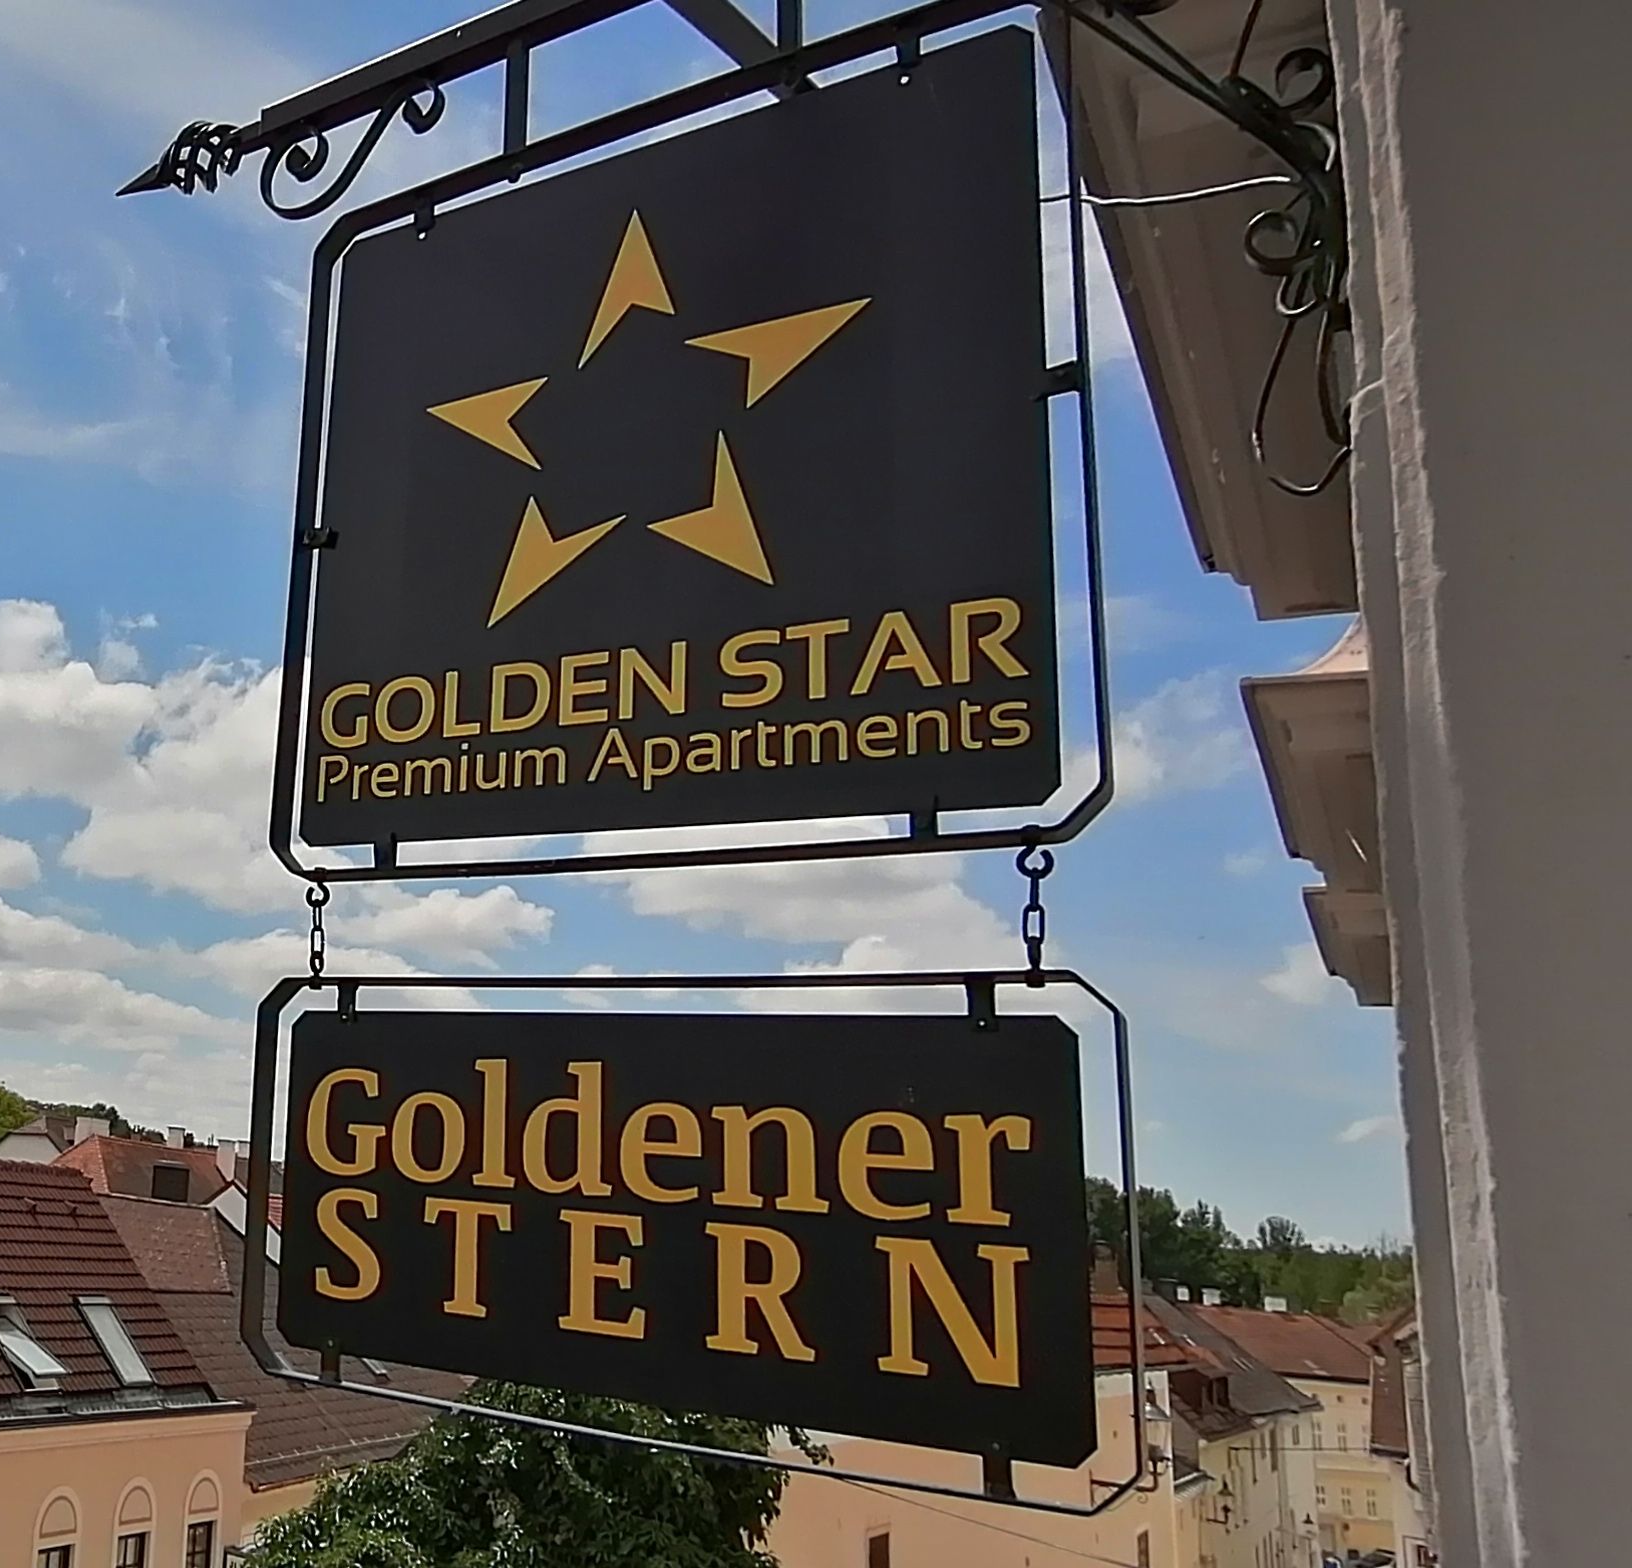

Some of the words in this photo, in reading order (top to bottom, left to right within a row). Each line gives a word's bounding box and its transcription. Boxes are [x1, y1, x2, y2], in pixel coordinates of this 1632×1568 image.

[317, 743, 566, 803] Premium
[587, 698, 1031, 791] Apartments
[321, 641, 687, 749] GOLDEN
[720, 597, 1030, 709] STAR
[306, 1058, 1031, 1227] Goldener
[314, 1187, 1030, 1389] STERN
